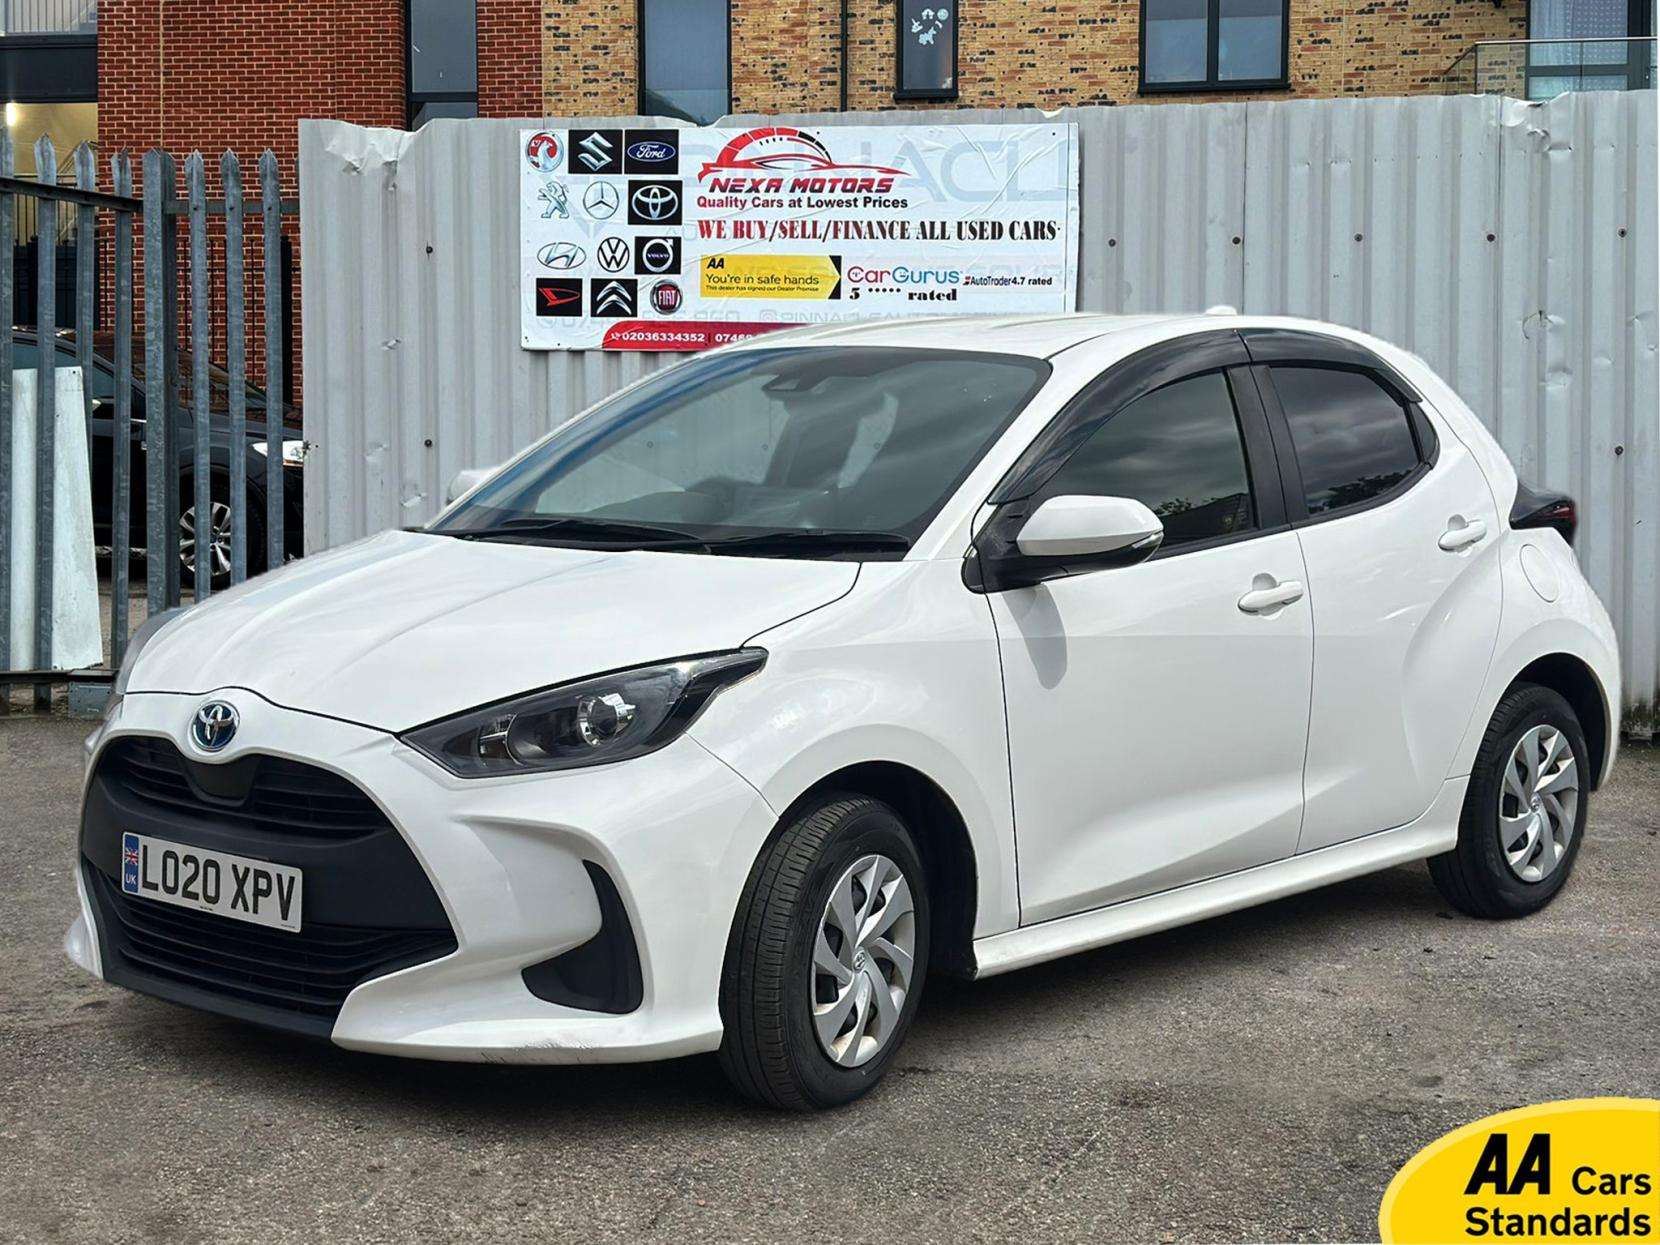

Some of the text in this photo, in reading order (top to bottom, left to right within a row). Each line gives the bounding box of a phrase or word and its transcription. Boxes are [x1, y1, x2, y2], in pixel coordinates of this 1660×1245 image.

[636, 145, 665, 158] Ford
[709, 178, 894, 193] NEXA MOTORS
[697, 196, 908, 210] Quality Cars at Lowest Prices
[697, 220, 727, 239] WE
[916, 221, 950, 240] ALL
[956, 221, 1004, 240] USED
[1008, 221, 1057, 240] CARS
[706, 257, 724, 269] AA
[706, 273, 819, 285] You're in safe hands
[847, 266, 960, 284] CarGurus
[1028, 277, 1053, 286] rated
[658, 289, 676, 306] FIAT
[849, 287, 958, 301] 5 rated
[622, 333, 705, 342] 02036334352
[125, 873, 136, 886] UK
[142, 844, 295, 921] LO20 XPV
